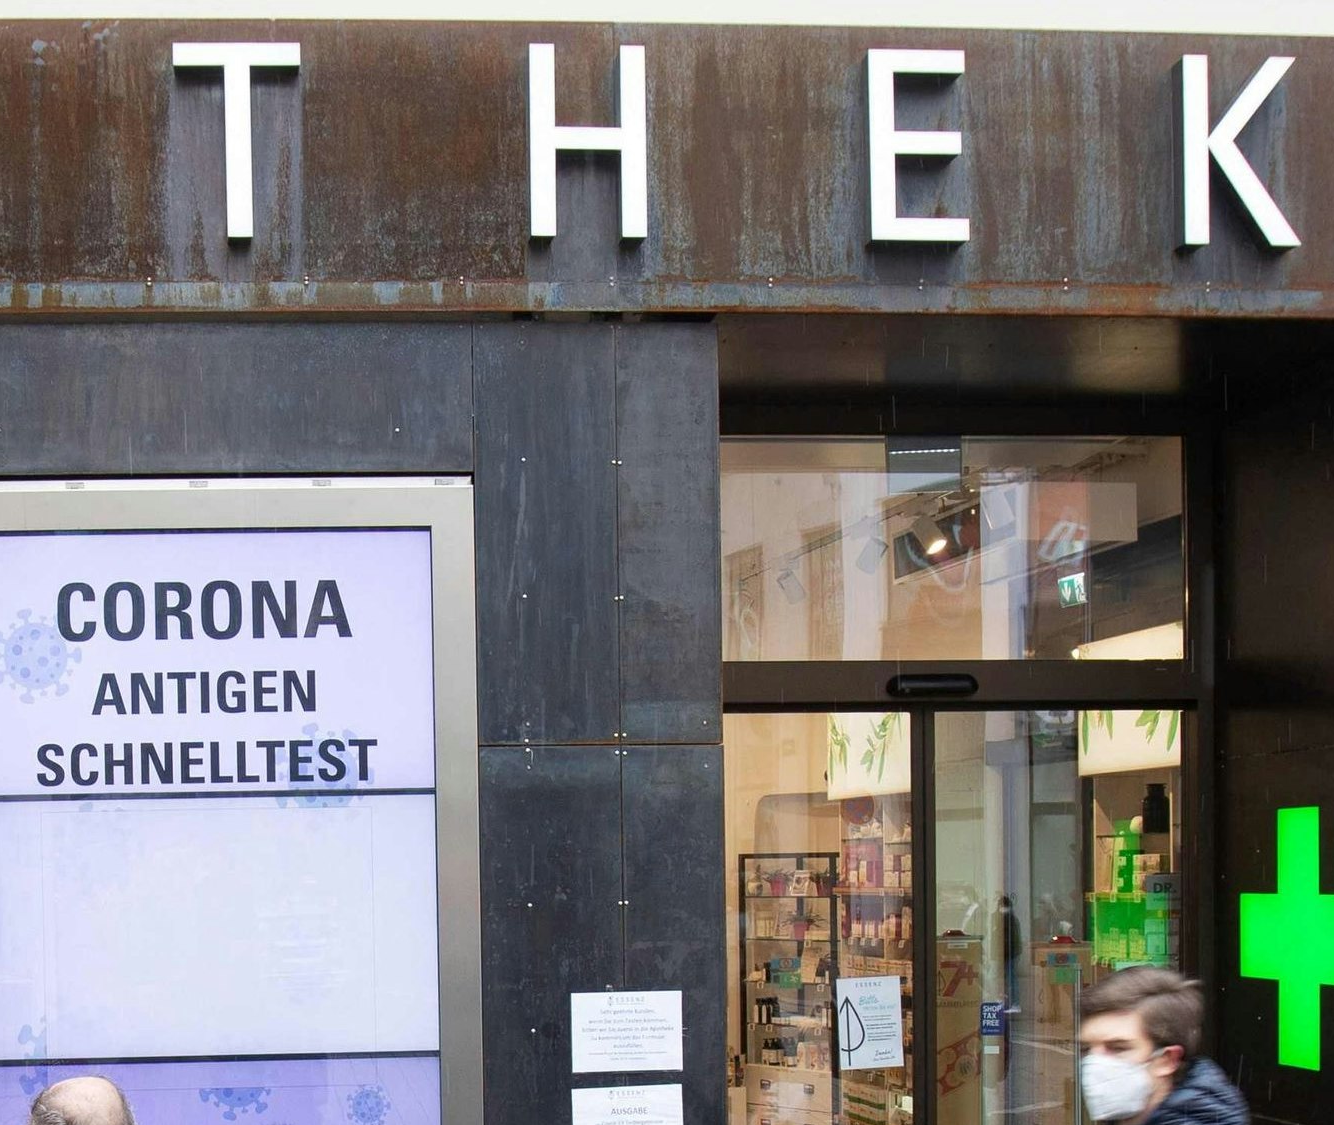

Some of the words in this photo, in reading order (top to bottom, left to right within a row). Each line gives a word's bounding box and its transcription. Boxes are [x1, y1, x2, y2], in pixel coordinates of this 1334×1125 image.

[56, 578, 354, 644] CORONA
[91, 669, 317, 716] ANTIGEN
[36, 738, 378, 787] SCHNELLTEST
[982, 1005, 1001, 1013] SHOP
[982, 1019, 1000, 1027] FREE
[610, 1106, 648, 1116] AUSGABE
